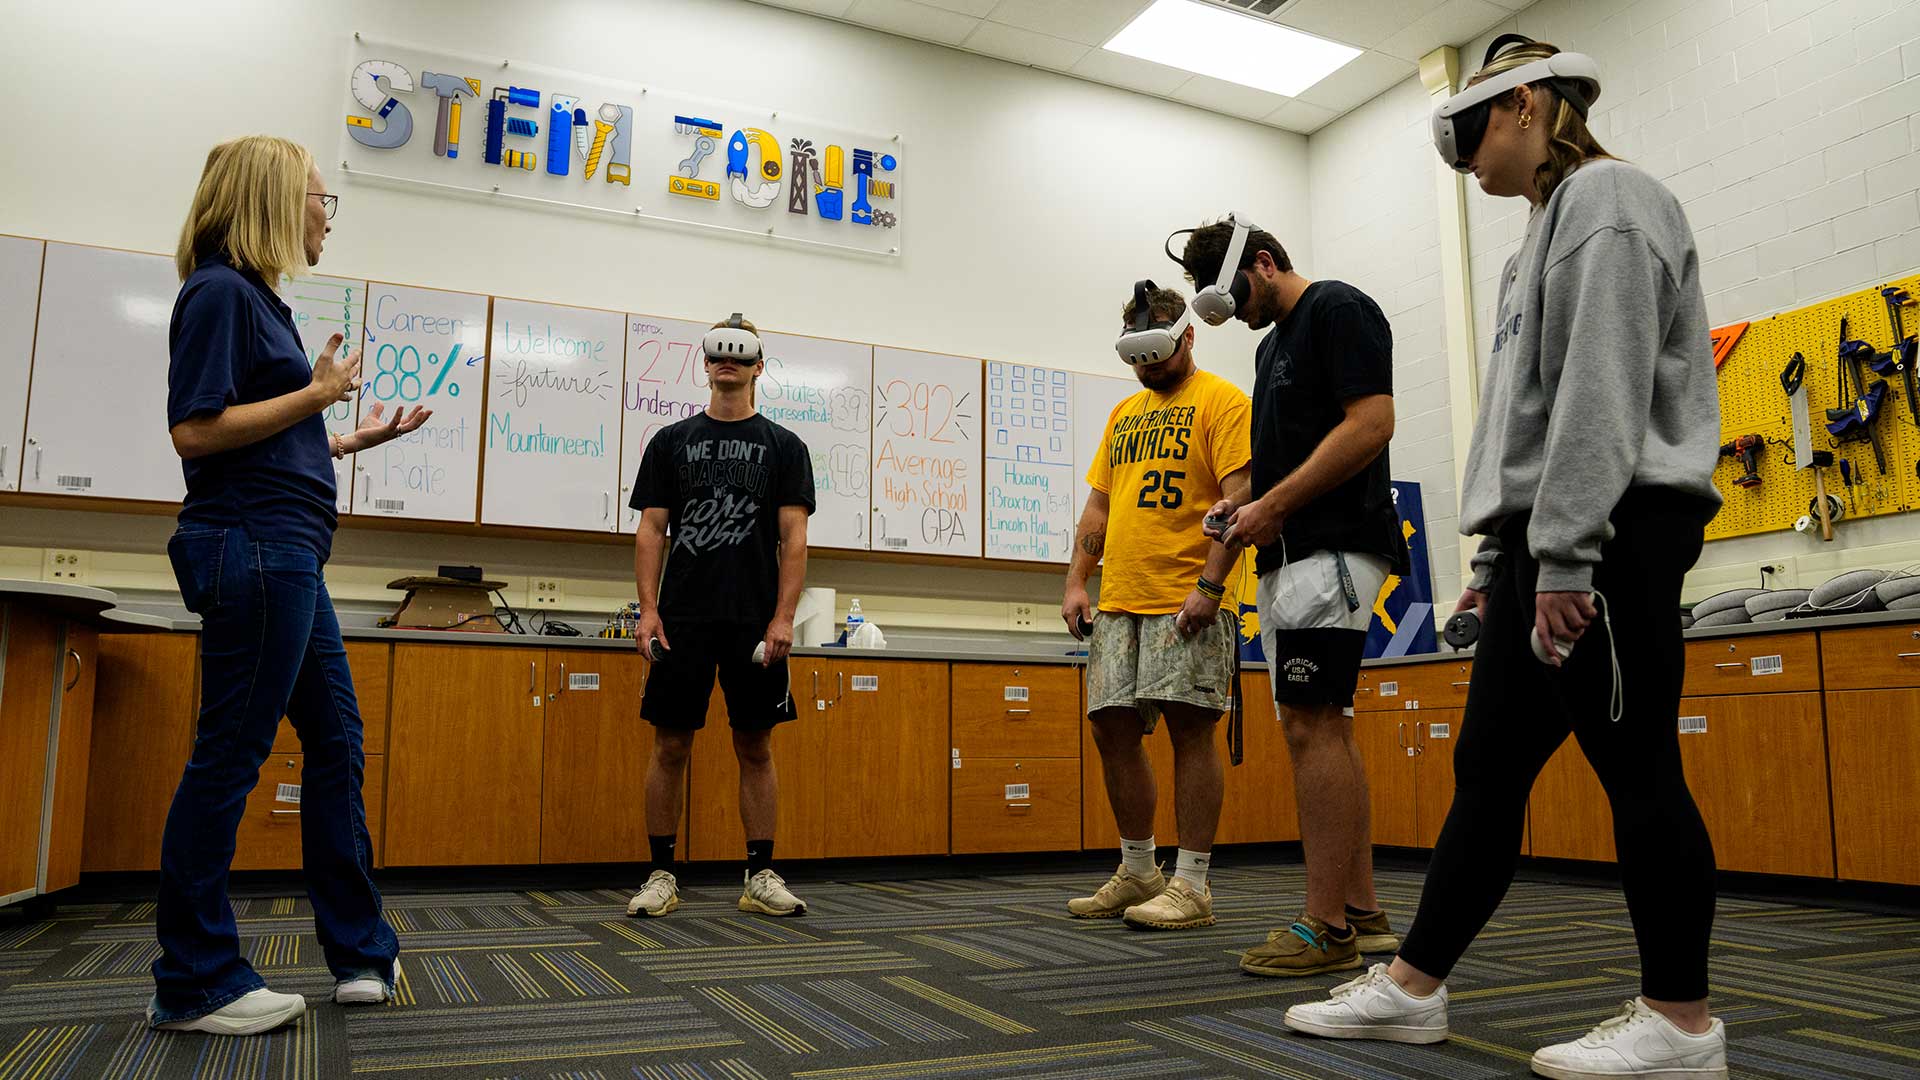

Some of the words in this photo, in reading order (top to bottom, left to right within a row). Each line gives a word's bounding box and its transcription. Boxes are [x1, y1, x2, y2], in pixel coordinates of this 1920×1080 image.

[346, 58, 632, 186] STEM
[668, 114, 897, 230] ZONE
[375, 294, 464, 336] Career
[632, 321, 664, 336] approx.
[505, 321, 609, 362] Welcome
[372, 343, 464, 402] 88%
[503, 359, 601, 408] future
[761, 356, 826, 407] States
[836, 393, 861, 422] 39
[886, 379, 954, 443] 3.92
[490, 411, 606, 457] Mountaineers!
[685, 439, 714, 462] WE
[717, 439, 767, 464] DON'T
[384, 444, 446, 496] Rate
[679, 459, 768, 498] BLACKOUT
[836, 449, 866, 490] 46
[876, 440, 968, 489] Average
[1004, 462, 1049, 492] Housing
[713, 484, 728, 499] WE
[884, 477, 917, 511] High
[921, 480, 968, 512] School
[991, 485, 1041, 512] Braxton
[1136, 469, 1186, 510] 25
[680, 493, 749, 526] COAL
[921, 507, 966, 546] GPA
[989, 510, 1028, 533] Lincoln
[1030, 513, 1049, 535] Hall
[671, 518, 756, 557] RUSH
[1029, 535, 1049, 558] Hall
[1283, 657, 1319, 673] AMERICAN
[1287, 673, 1310, 683] EAGLE
[1291, 666, 1306, 674] USA
